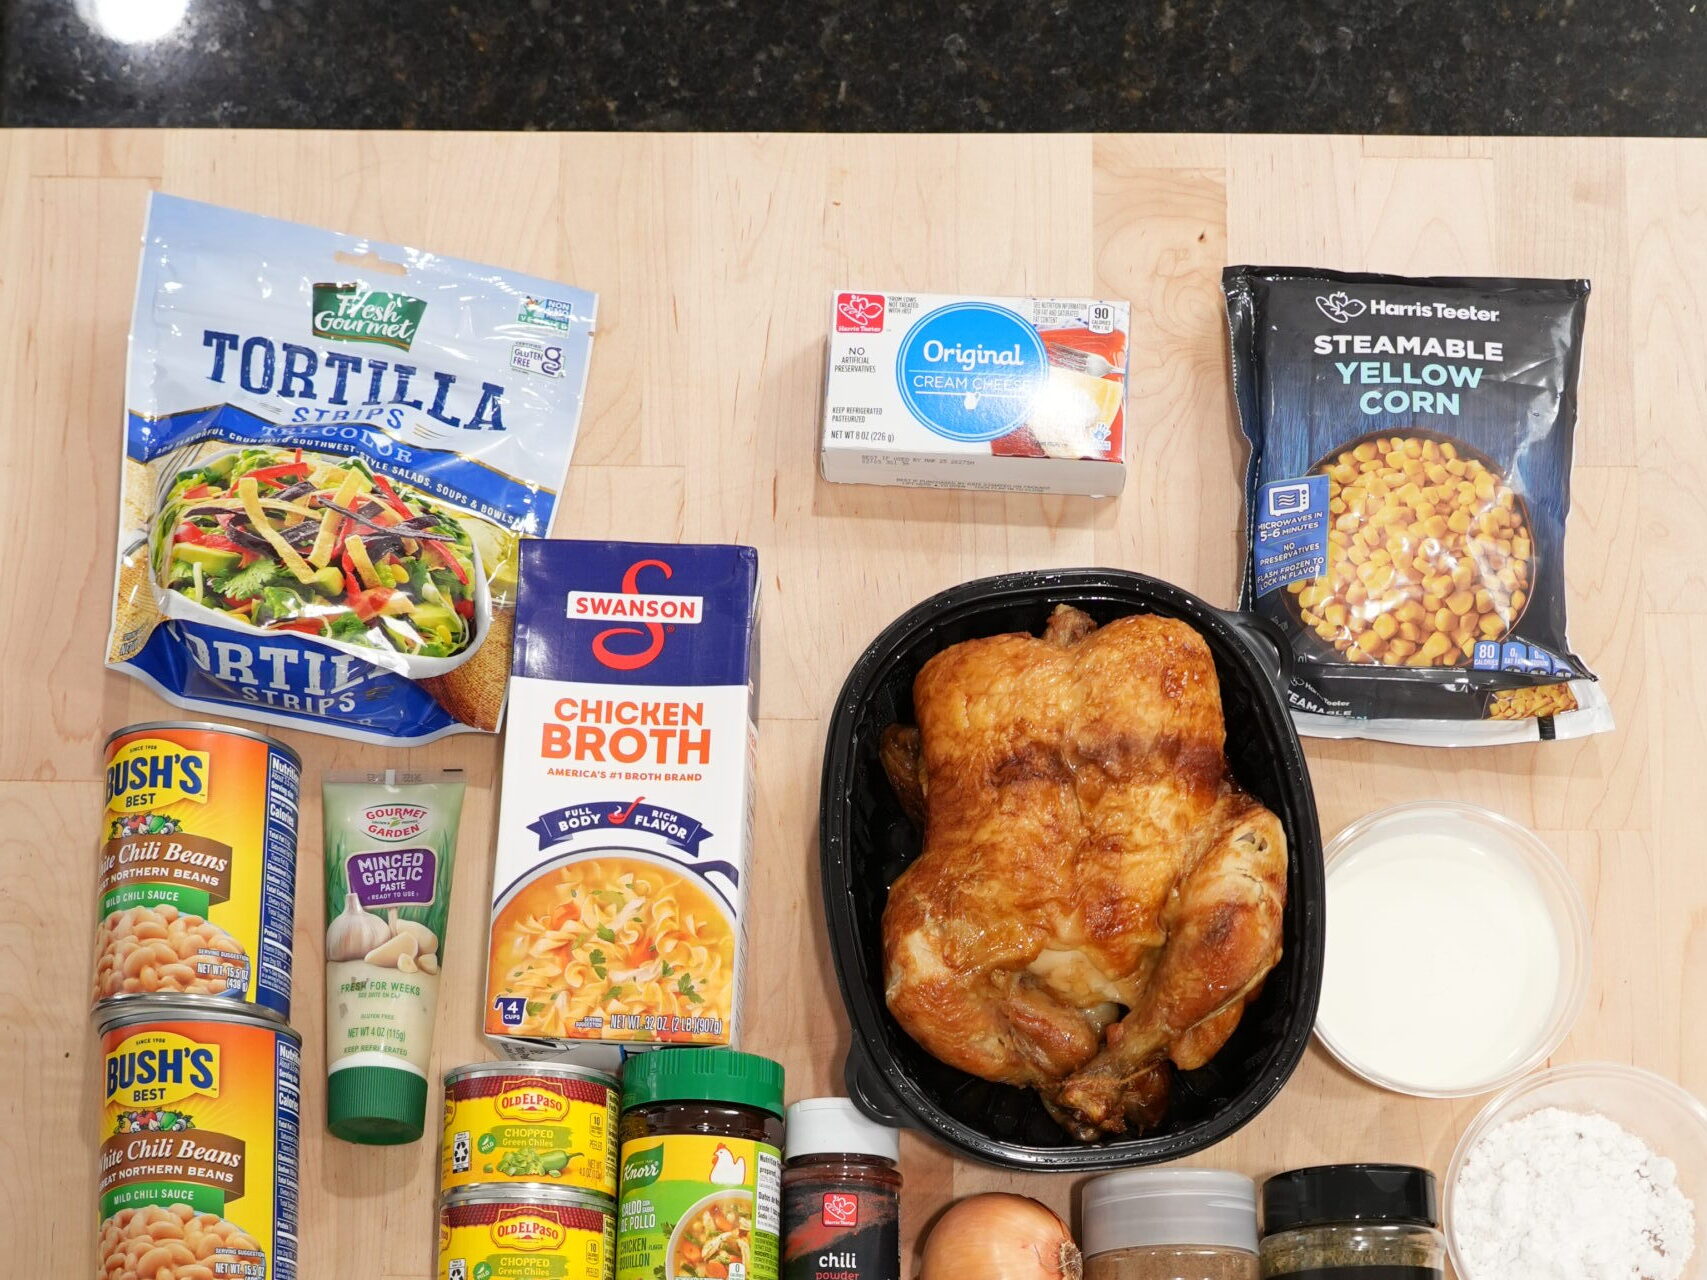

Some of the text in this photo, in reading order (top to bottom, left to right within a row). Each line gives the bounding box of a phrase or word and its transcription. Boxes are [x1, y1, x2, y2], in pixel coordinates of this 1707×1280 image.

[336, 288, 401, 322] Fresh
[1094, 307, 1109, 319] 90
[1371, 300, 1499, 321] Harris Teeter
[314, 311, 413, 340] Gourmet
[514, 349, 543, 361] GLUTEN
[849, 347, 865, 355] NO
[923, 339, 1024, 371] Original
[1314, 335, 1504, 362] STEAMABLE
[513, 356, 530, 367] FREE
[841, 356, 870, 364] ARTIFICIAL
[834, 365, 876, 373] PRESERVATIVES
[1335, 362, 1483, 389] YELLOW
[202, 329, 506, 431] TORTILLA
[913, 375, 1031, 392] CREAM CHEESE
[846, 407, 882, 415] REFRIGERATED
[1360, 390, 1460, 416] CORN
[292, 404, 404, 430] STRIPS
[832, 415, 866, 423] PASTEURIZED
[261, 424, 412, 463] TRI-COLOR
[831, 430, 843, 439] NET
[845, 431, 855, 440] WT
[861, 432, 870, 441] OZ
[436, 484, 467, 504] SOUPS
[470, 500, 477, 509] &
[480, 504, 514, 524] BOWLS
[1258, 514, 1312, 530] MICROWAVES
[1260, 522, 1319, 542] 5-6 MINUTES
[1261, 543, 1320, 566] PRESERVATIVES
[1284, 543, 1295, 551] NO
[1258, 570, 1278, 583] FLASH
[1280, 559, 1310, 573] FROZEN
[1261, 577, 1277, 590] LOCK
[576, 597, 696, 618] SWANSON
[1479, 644, 1495, 659] 80
[241, 686, 356, 715] STRIPS
[554, 698, 704, 726] CHICKEN
[541, 722, 711, 765] BROTH
[105, 753, 203, 808] BUSH'S
[547, 768, 702, 782] AMERICA'S #1 BROTH BRAND
[125, 793, 156, 808] BEST
[366, 808, 427, 819] GOURMET
[565, 808, 592, 818] FULL
[652, 809, 677, 822] RICH
[368, 824, 419, 837] GARDEN
[558, 814, 601, 832] BODY
[634, 815, 688, 839] FLAVOR
[118, 841, 228, 872] Chili Beans
[358, 853, 423, 872] MINCED
[111, 867, 220, 886] NORTHERN BEANS
[362, 868, 423, 885] GARLIC
[381, 882, 406, 891] PASTE
[123, 891, 145, 903] CHILI
[147, 890, 179, 902] SAUCE
[372, 892, 391, 900] READY
[197, 963, 210, 974] NET
[241, 969, 249, 980] OZ
[341, 982, 420, 996] FRESH FOR WEEKS
[507, 1002, 518, 1013] 4
[610, 1014, 626, 1029] NET
[628, 1015, 643, 1030] WT.
[645, 1015, 655, 1030] 32
[656, 1016, 669, 1031] OZ.
[348, 1028, 359, 1038] NET
[360, 1027, 369, 1036] WT
[377, 1027, 385, 1036] OZ
[387, 1028, 406, 1042] (115g)
[344, 1045, 407, 1056] KEEP REFRIERATED
[106, 1047, 214, 1098] BUSH'S
[133, 1088, 166, 1102] BEST
[502, 1094, 562, 1111] OLD EL PASO
[504, 1128, 554, 1139] CHOPPED
[529, 1138, 553, 1147] Chiles
[127, 1139, 173, 1160] Chili
[177, 1140, 242, 1168] Beans
[119, 1165, 183, 1180] NORTHERN
[188, 1167, 233, 1183] BEANS
[624, 1163, 659, 1181] Knorr
[114, 1189, 194, 1205] MILD CHILI SAUCE
[622, 1200, 641, 1217] CALDO
[498, 1222, 558, 1239] OLD EL PASO
[630, 1214, 656, 1231] POLLO
[621, 1237, 646, 1254] CHICKEN
[500, 1257, 550, 1267] CHOPPED
[620, 1253, 650, 1270] BOUILLON
[819, 1252, 857, 1269] chili
[215, 1263, 228, 1273] NET
[245, 1264, 257, 1275] 15.5
[258, 1266, 265, 1277] OZ
[524, 1268, 549, 1276] Chiles
[816, 1271, 860, 1280] powder
